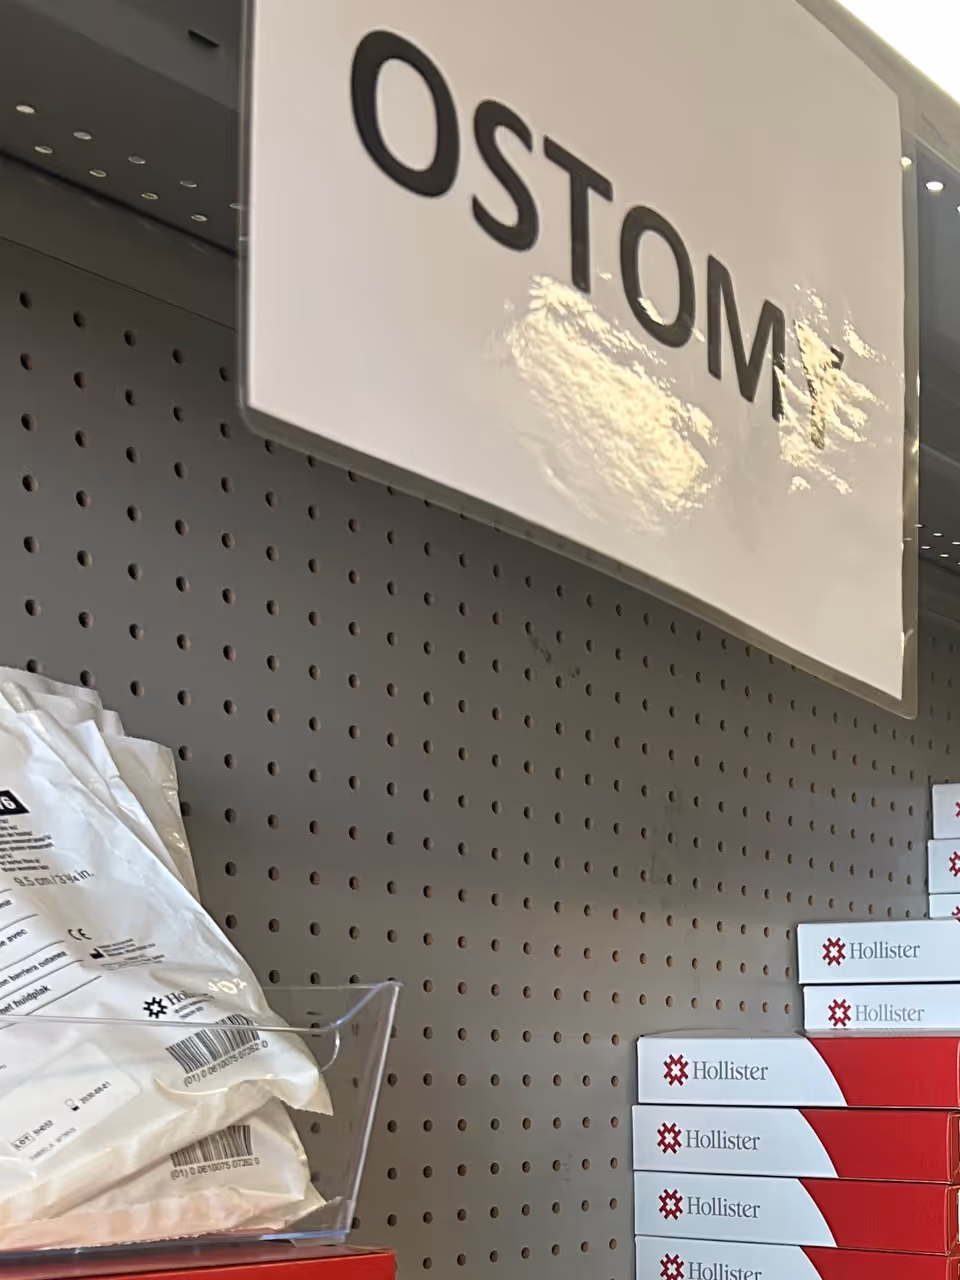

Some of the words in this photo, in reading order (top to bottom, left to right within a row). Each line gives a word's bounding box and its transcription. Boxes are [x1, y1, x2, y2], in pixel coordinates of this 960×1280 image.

[850, 942, 920, 960] Hollister
[855, 1004, 925, 1022] Hollister
[692, 1060, 768, 1081] Hollister
[685, 1129, 760, 1151] Hollister
[687, 1196, 760, 1219] Hollister
